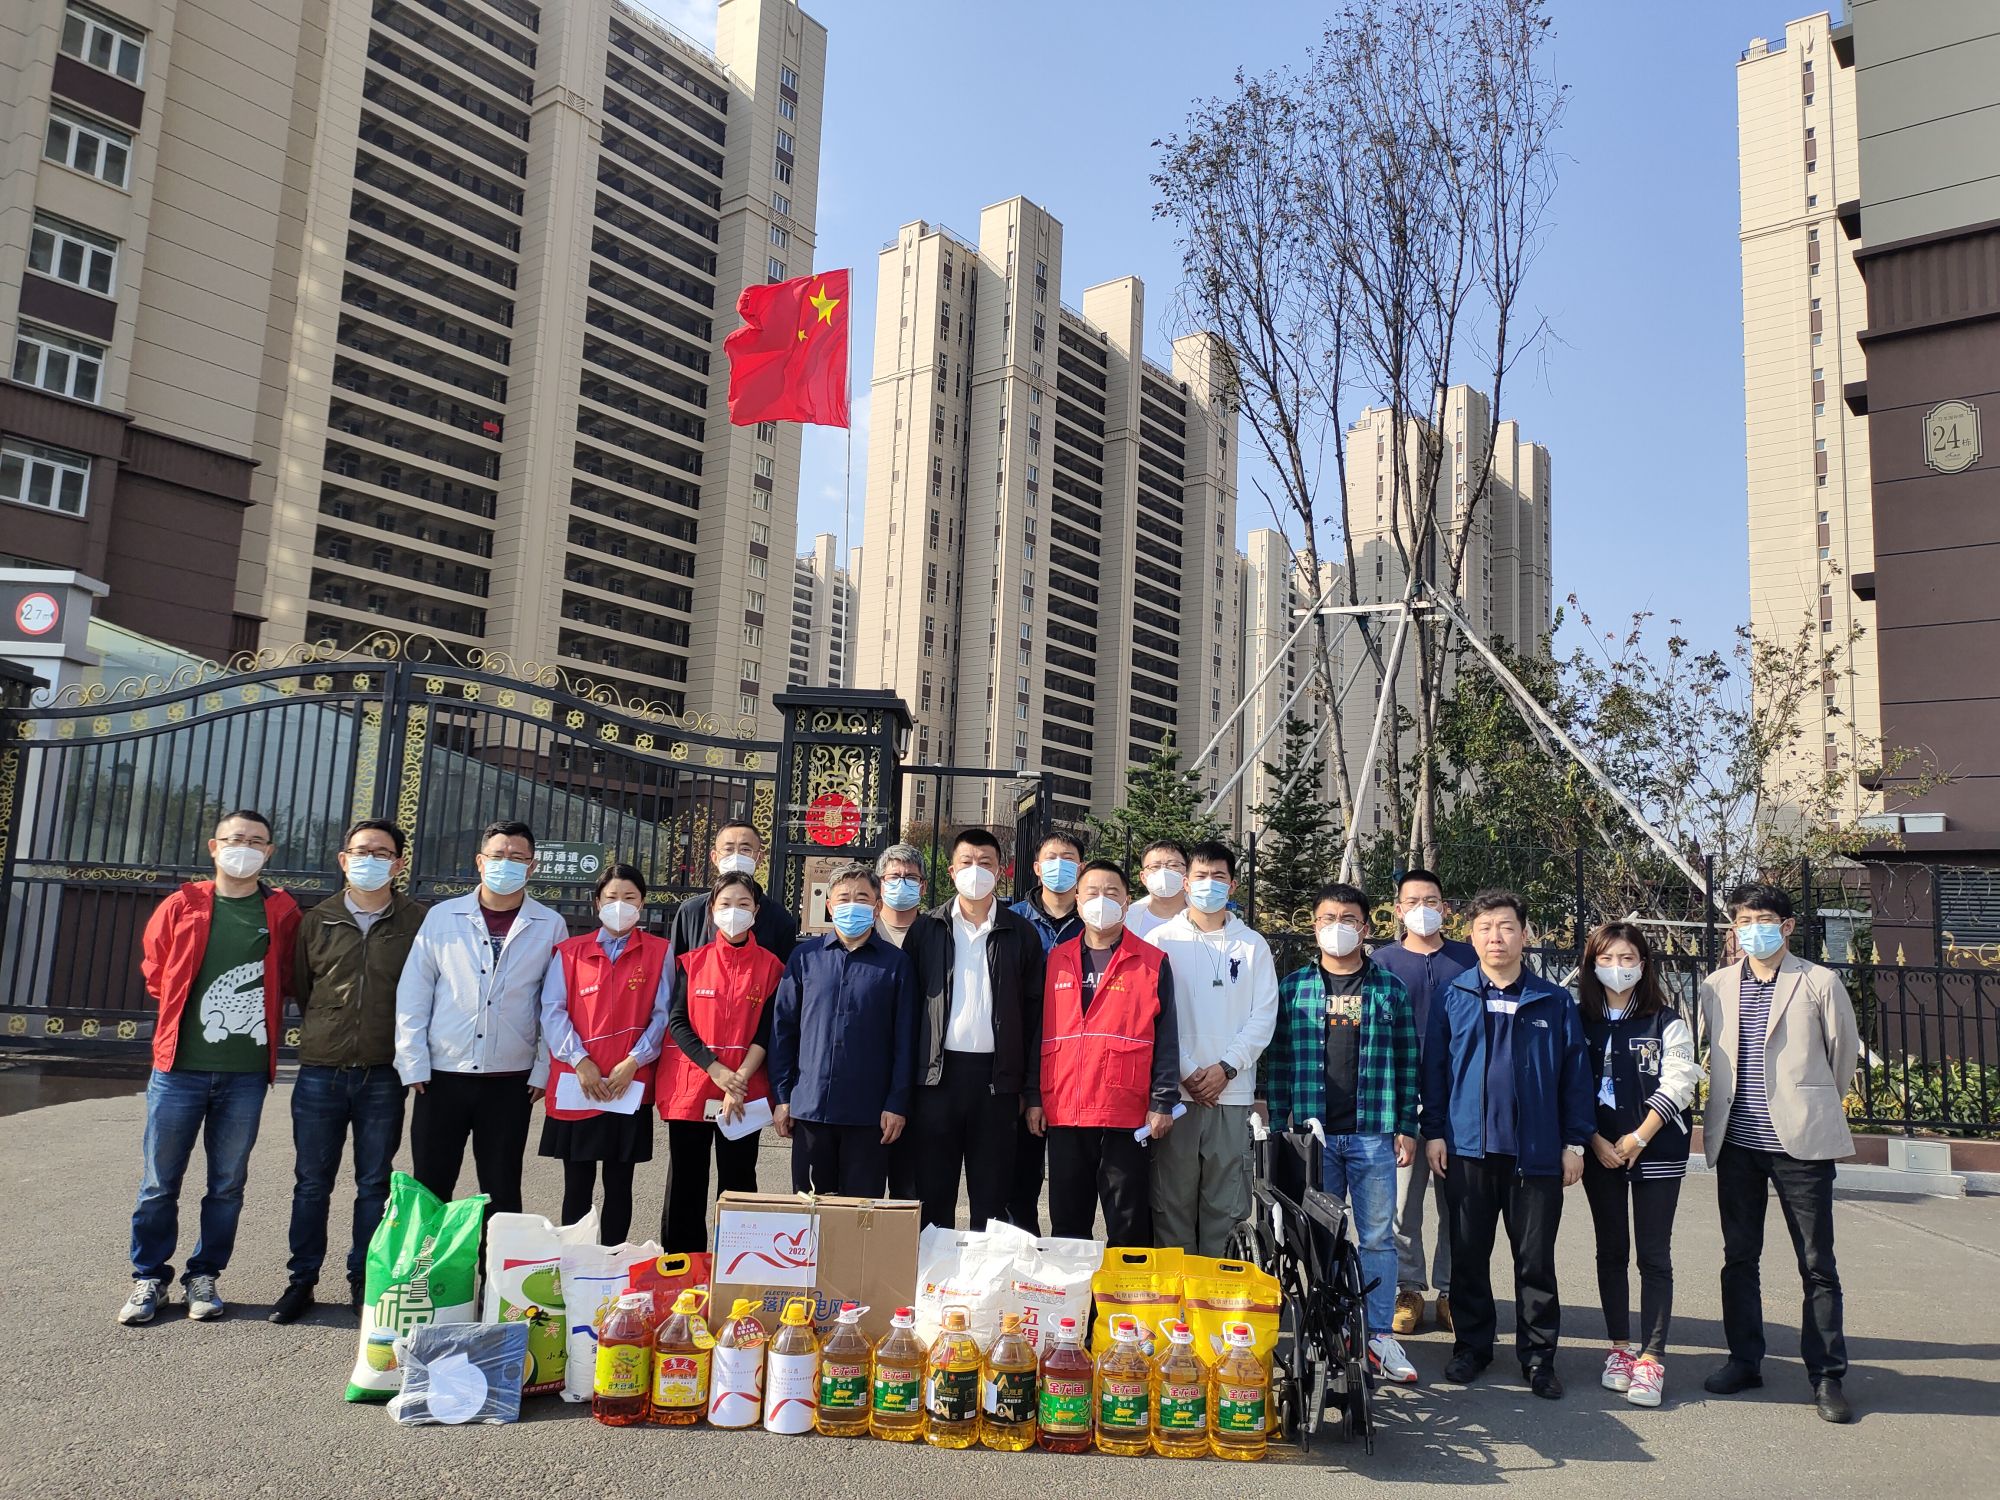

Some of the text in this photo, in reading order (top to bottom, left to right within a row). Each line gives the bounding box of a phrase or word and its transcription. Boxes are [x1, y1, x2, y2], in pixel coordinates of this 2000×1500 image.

[788, 1247, 806, 1256] 2022
[831, 1366, 860, 1376] 金龙鱼
[882, 1370, 911, 1380] 金龙鱼
[1048, 1382, 1085, 1395] 金龙鱼
[1111, 1384, 1141, 1395] 金龙鱼
[1170, 1387, 1199, 1398] 金龙鱼
[1229, 1389, 1259, 1400] 金龙鱼
